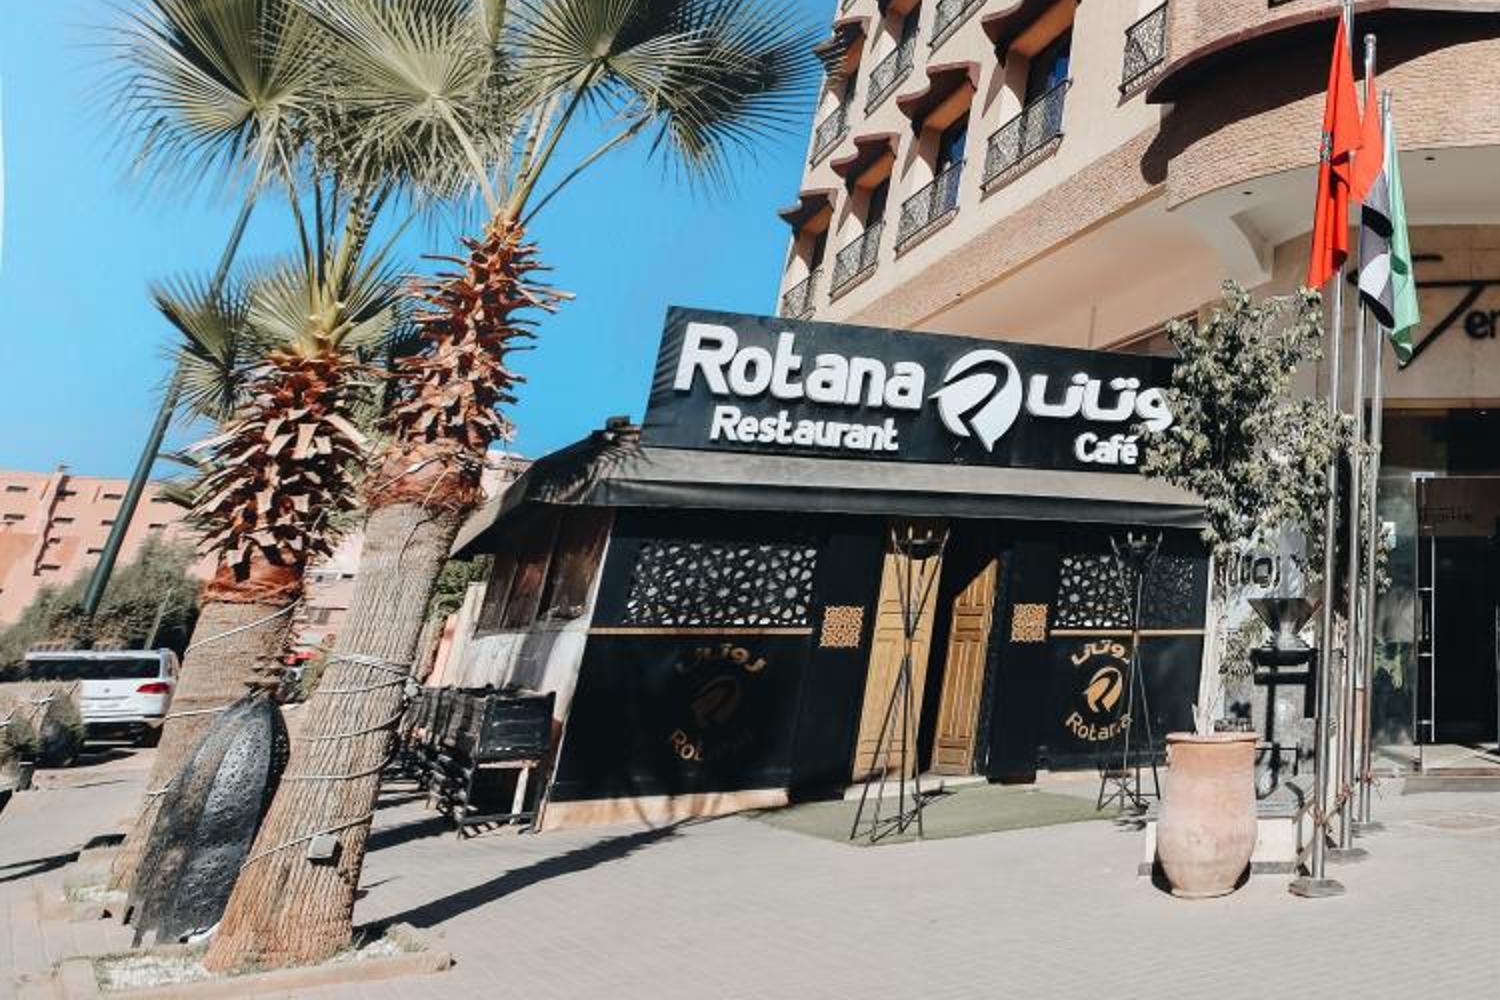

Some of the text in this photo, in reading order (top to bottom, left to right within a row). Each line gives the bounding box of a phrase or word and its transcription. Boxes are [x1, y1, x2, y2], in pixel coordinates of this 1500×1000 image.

[673, 321, 926, 410] Rotana
[1027, 372, 1175, 433] وتانا
[709, 405, 900, 451] Restaurant
[1074, 431, 1140, 465] Café
[1065, 711, 1133, 741] Rotana
